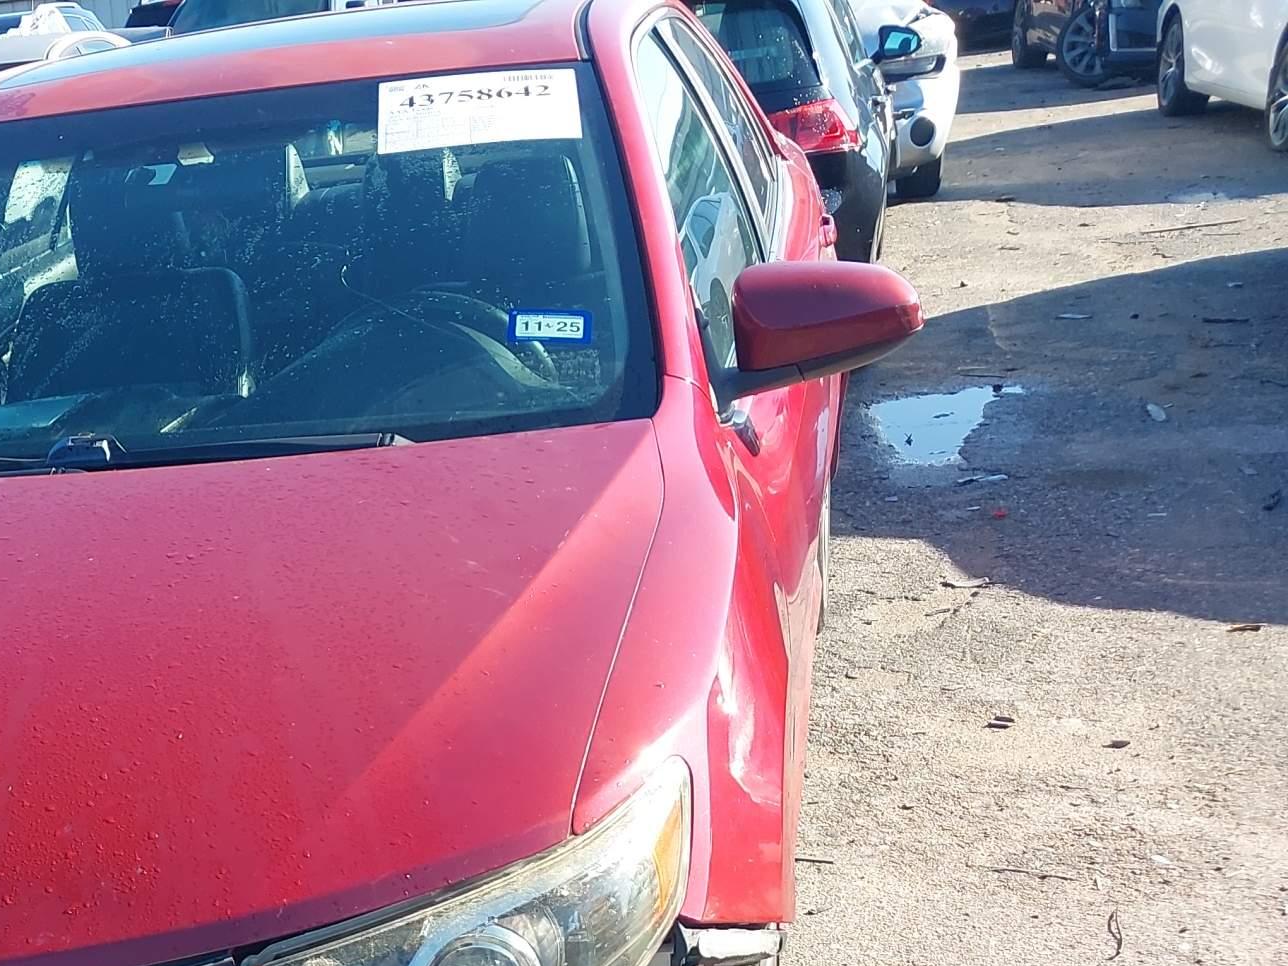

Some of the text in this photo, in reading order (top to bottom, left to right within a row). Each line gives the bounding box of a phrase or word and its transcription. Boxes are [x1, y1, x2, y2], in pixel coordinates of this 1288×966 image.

[399, 84, 552, 108] 43758642
[521, 320, 581, 333] 11 25
